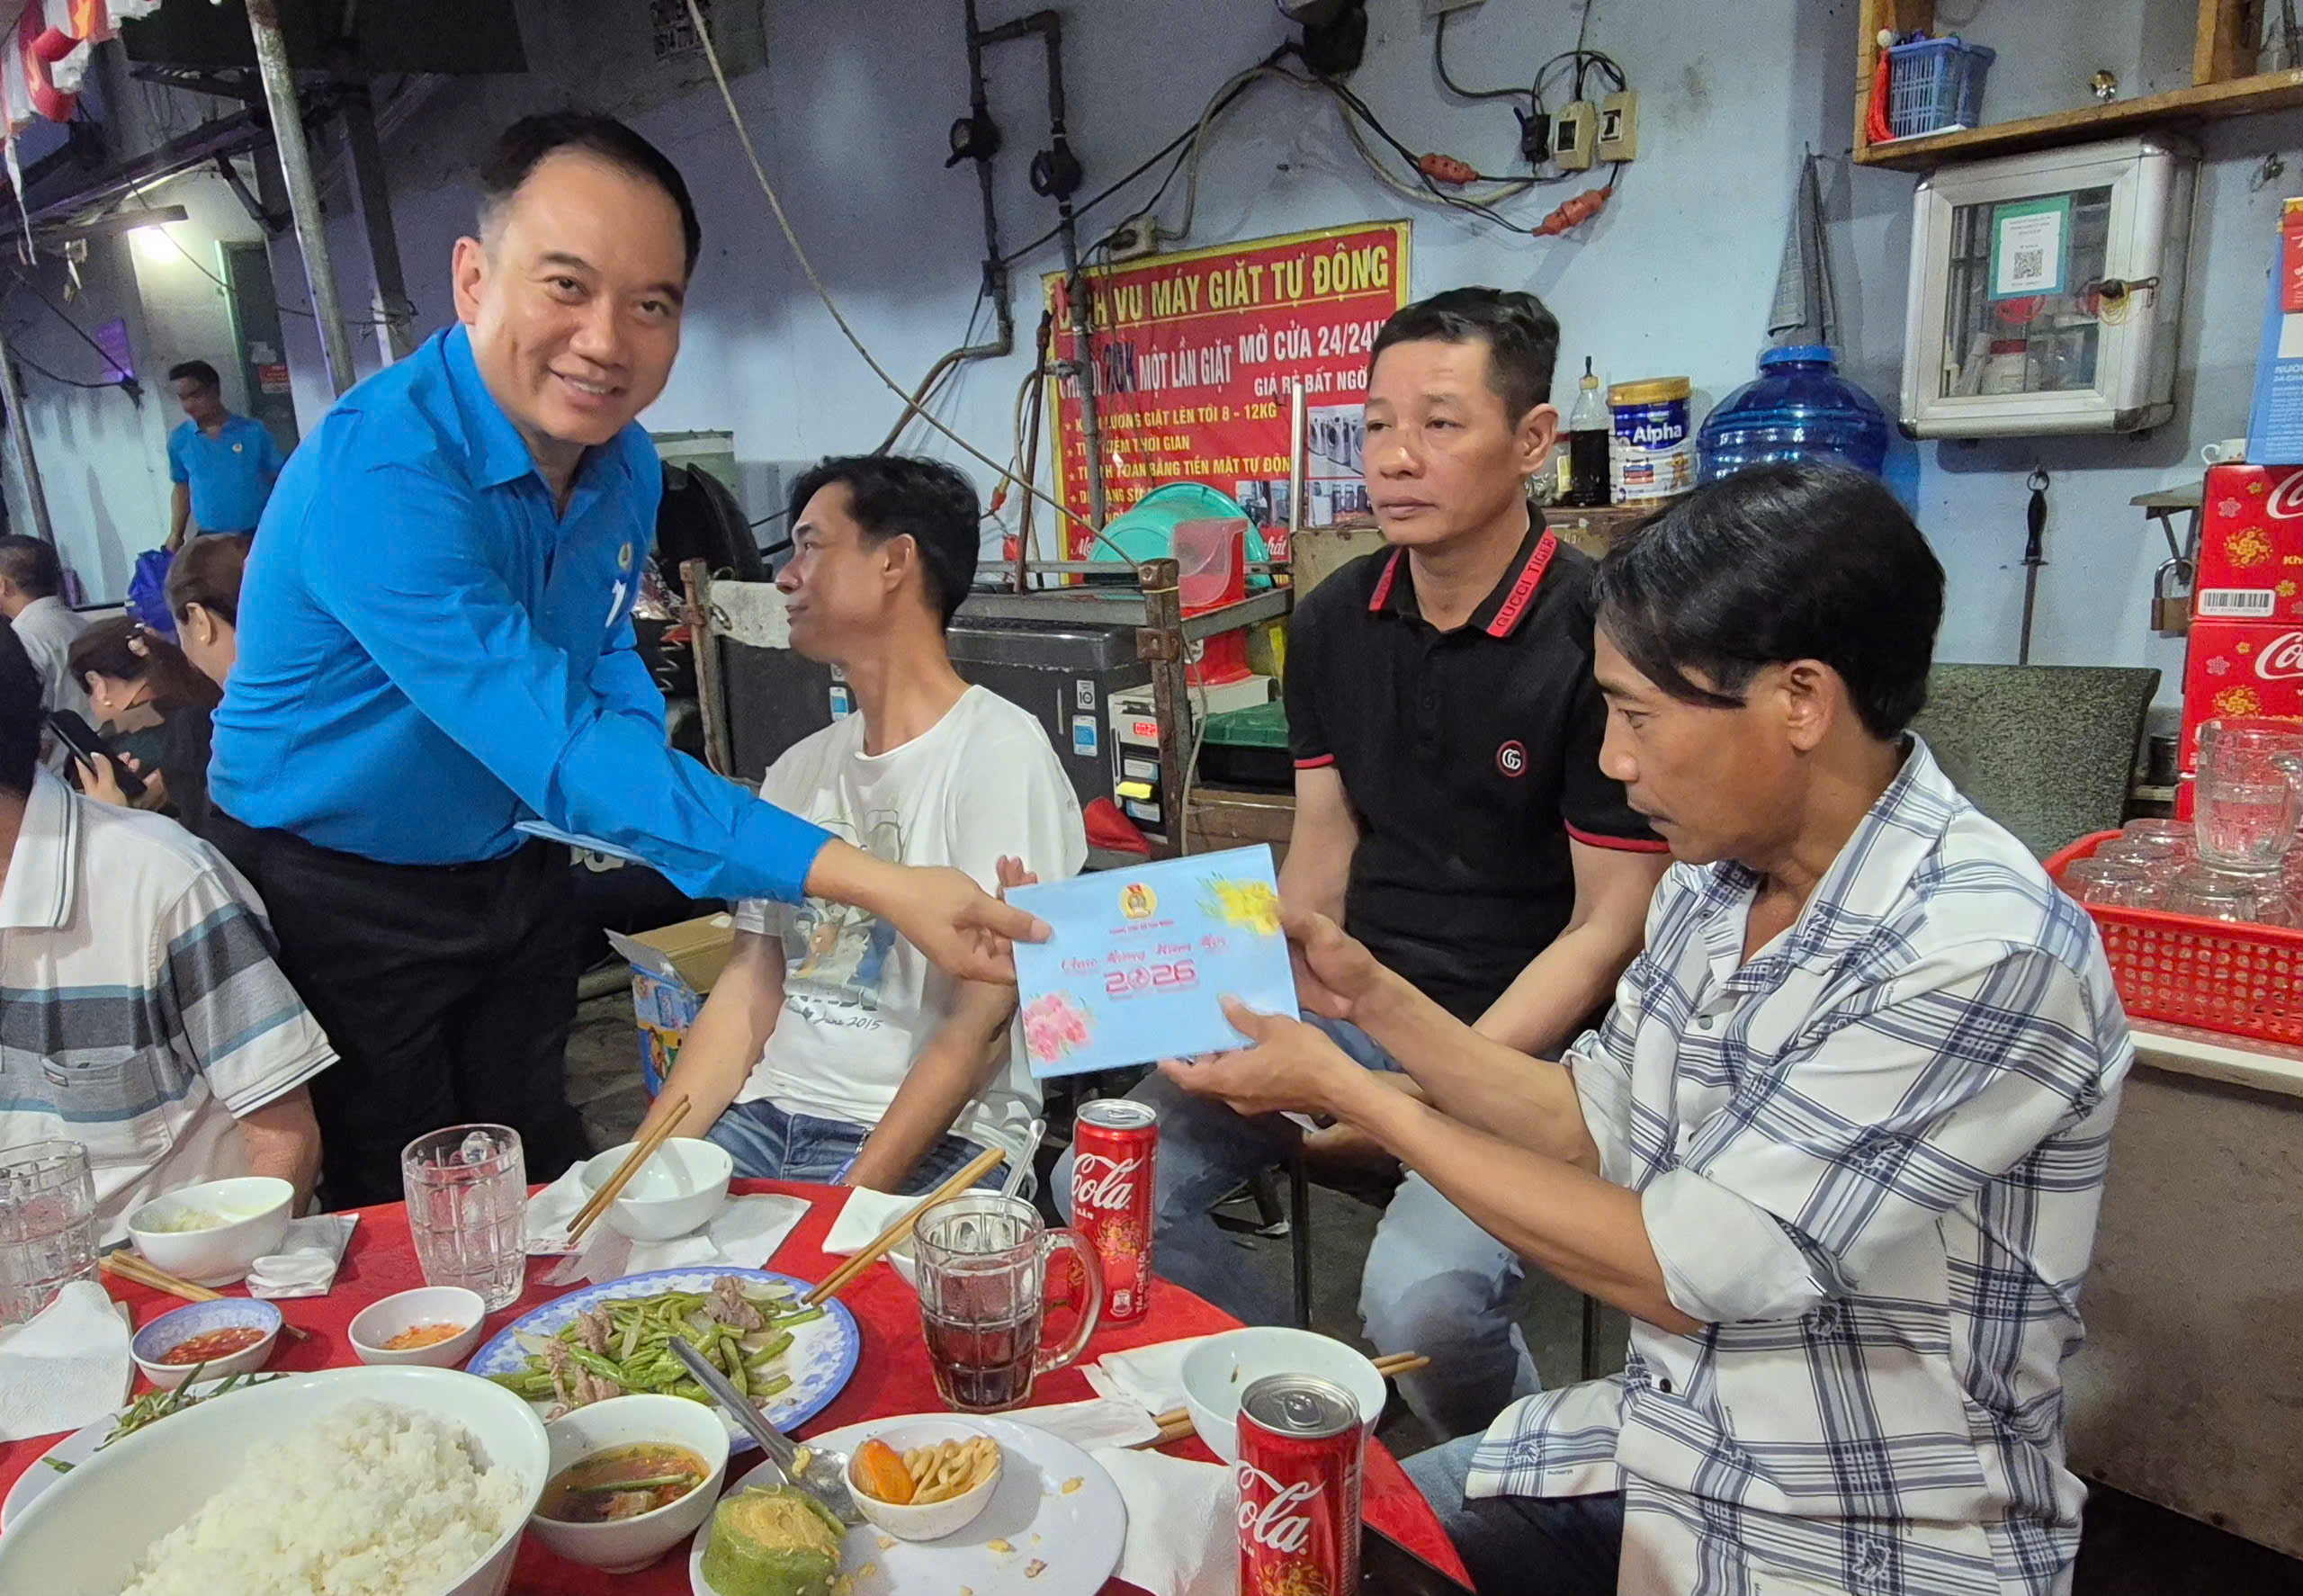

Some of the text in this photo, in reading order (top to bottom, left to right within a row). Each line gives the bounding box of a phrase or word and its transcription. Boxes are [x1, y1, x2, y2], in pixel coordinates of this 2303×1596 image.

[1152, 268, 1201, 317] MÁY
[1208, 258, 1264, 315] GIẶT
[1270, 251, 1310, 308] TỰ
[1312, 242, 1389, 303] ĐỘNG
[1239, 323, 1268, 364] MỞ
[1274, 319, 1313, 360] CỬA
[1139, 344, 1169, 399] MỘT
[1171, 336, 1198, 389] LẦN
[1201, 338, 1233, 393] GIẶT
[1254, 372, 1277, 397] GIÁ
[1304, 365, 1332, 393] BẤT
[1172, 405, 1196, 425] LÊN
[1222, 406, 1230, 422] 8
[1243, 401, 1277, 420] 12KG
[1163, 435, 1190, 452] GIAN
[1633, 422, 1682, 446] Alpha
[1213, 456, 1240, 477] MẶT
[1496, 578, 1532, 628] GUCCI
[1104, 959, 1197, 996] 2026
[847, 1016, 884, 1031] 2015
